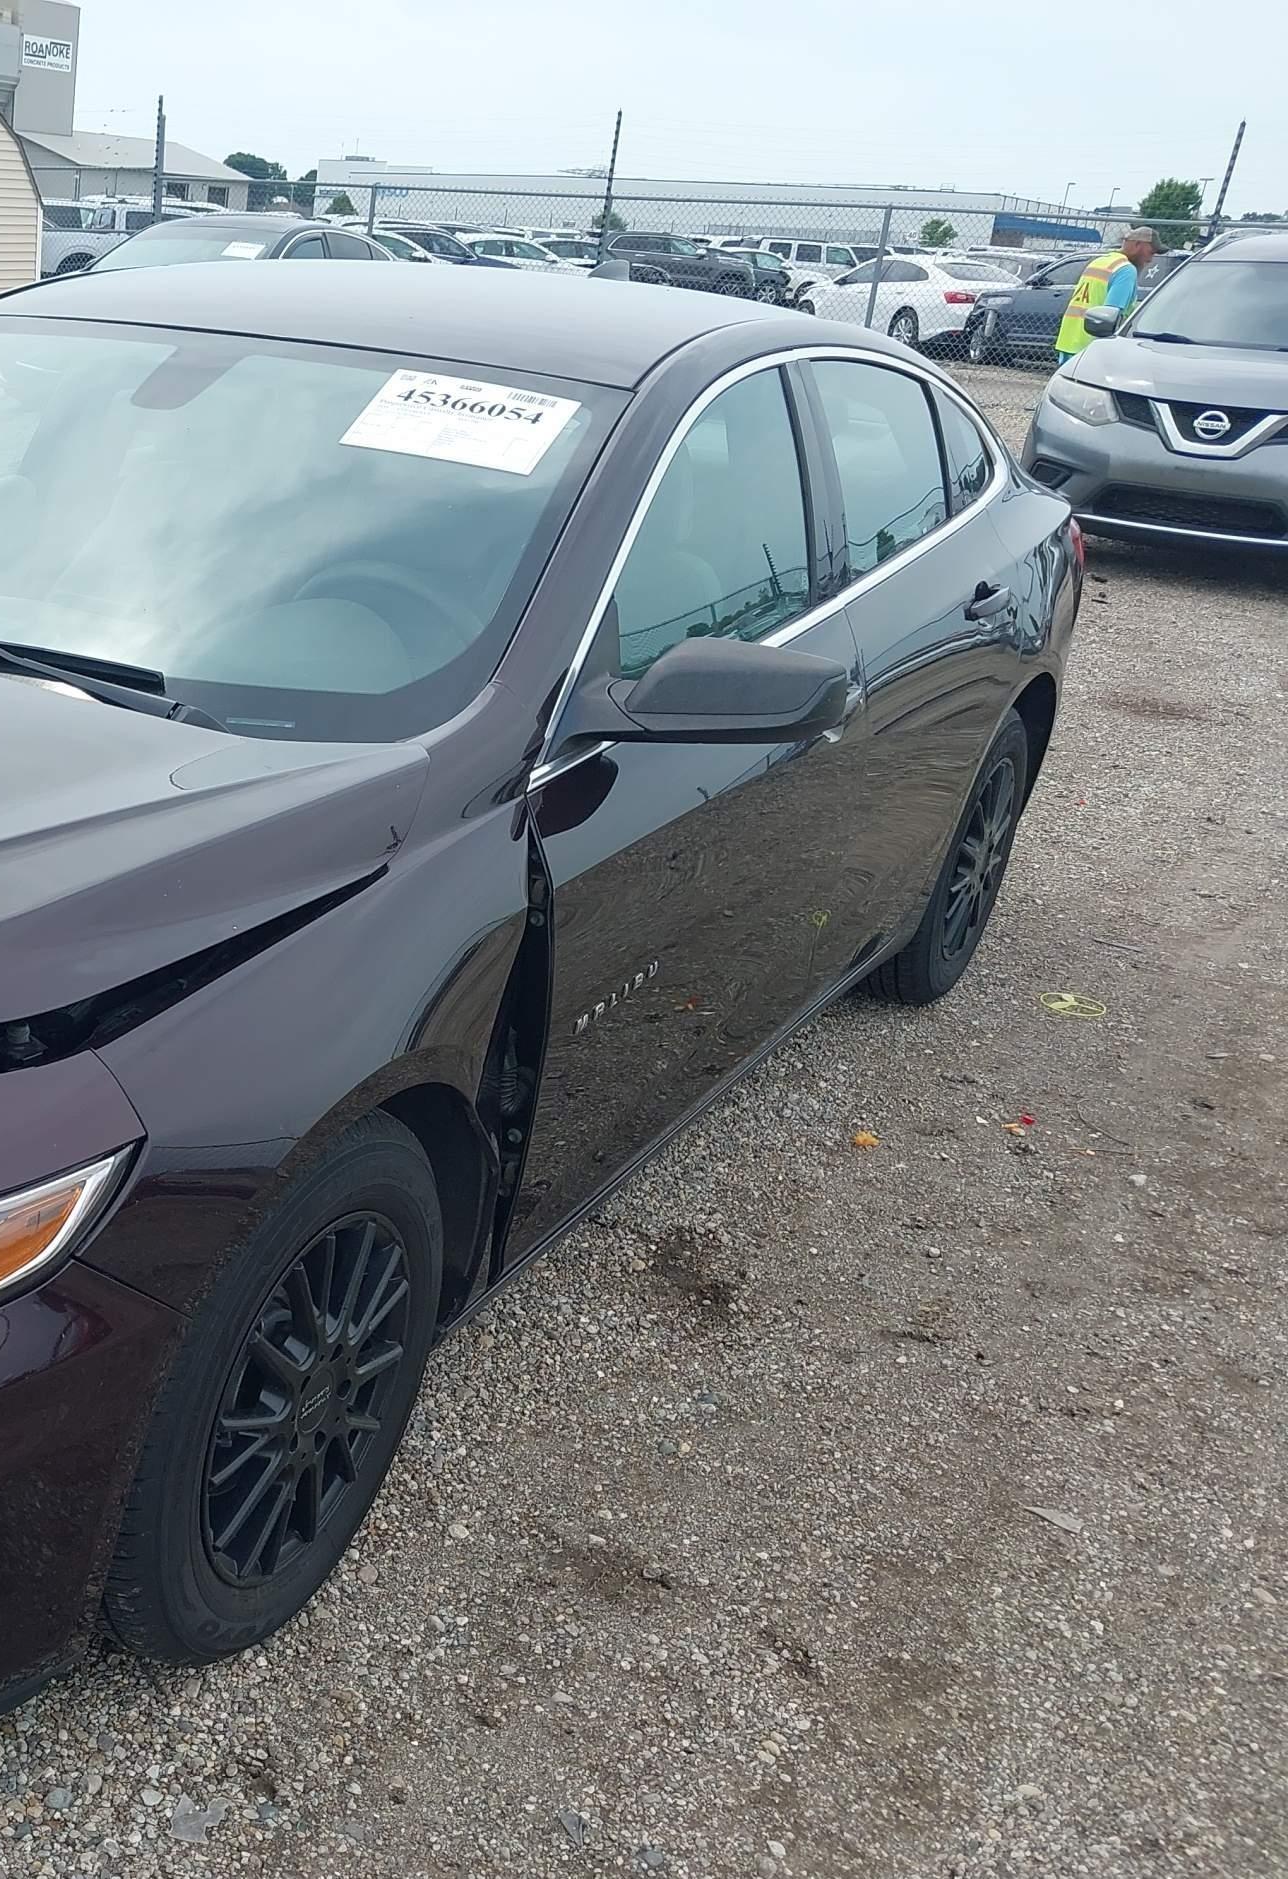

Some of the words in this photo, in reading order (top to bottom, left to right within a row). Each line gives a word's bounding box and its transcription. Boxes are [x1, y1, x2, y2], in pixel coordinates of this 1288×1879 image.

[24, 41, 71, 59] ROANOKE
[396, 388, 544, 425] 45366054
[1196, 420, 1227, 430] NISSAN
[574, 960, 659, 1036] MALIBU
